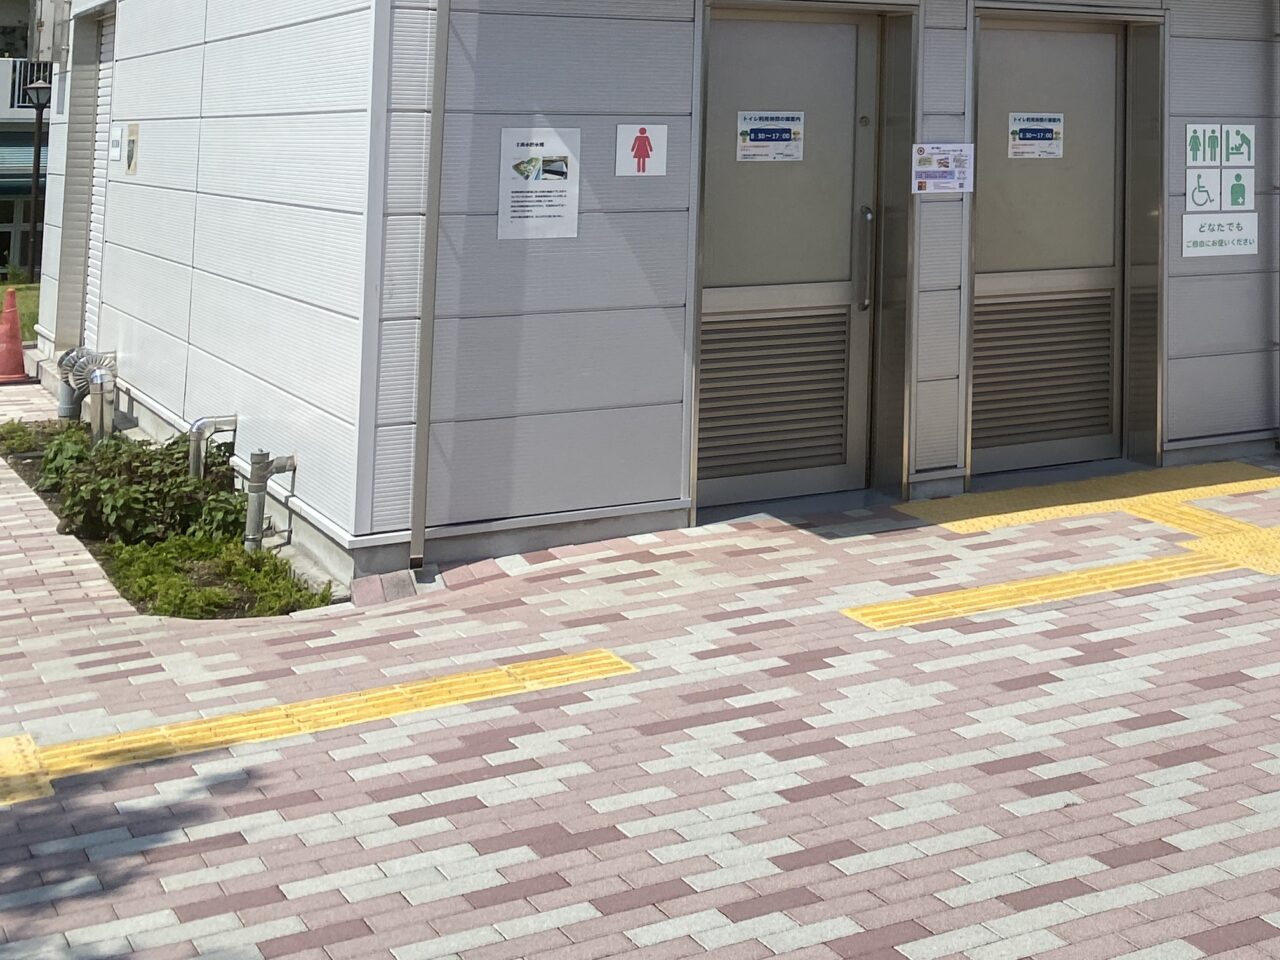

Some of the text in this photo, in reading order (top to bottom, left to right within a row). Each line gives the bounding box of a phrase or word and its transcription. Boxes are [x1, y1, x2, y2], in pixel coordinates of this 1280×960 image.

[1198, 222, 1243, 233] どなたでも
[1185, 239, 1255, 248] ご自由にお使いください
